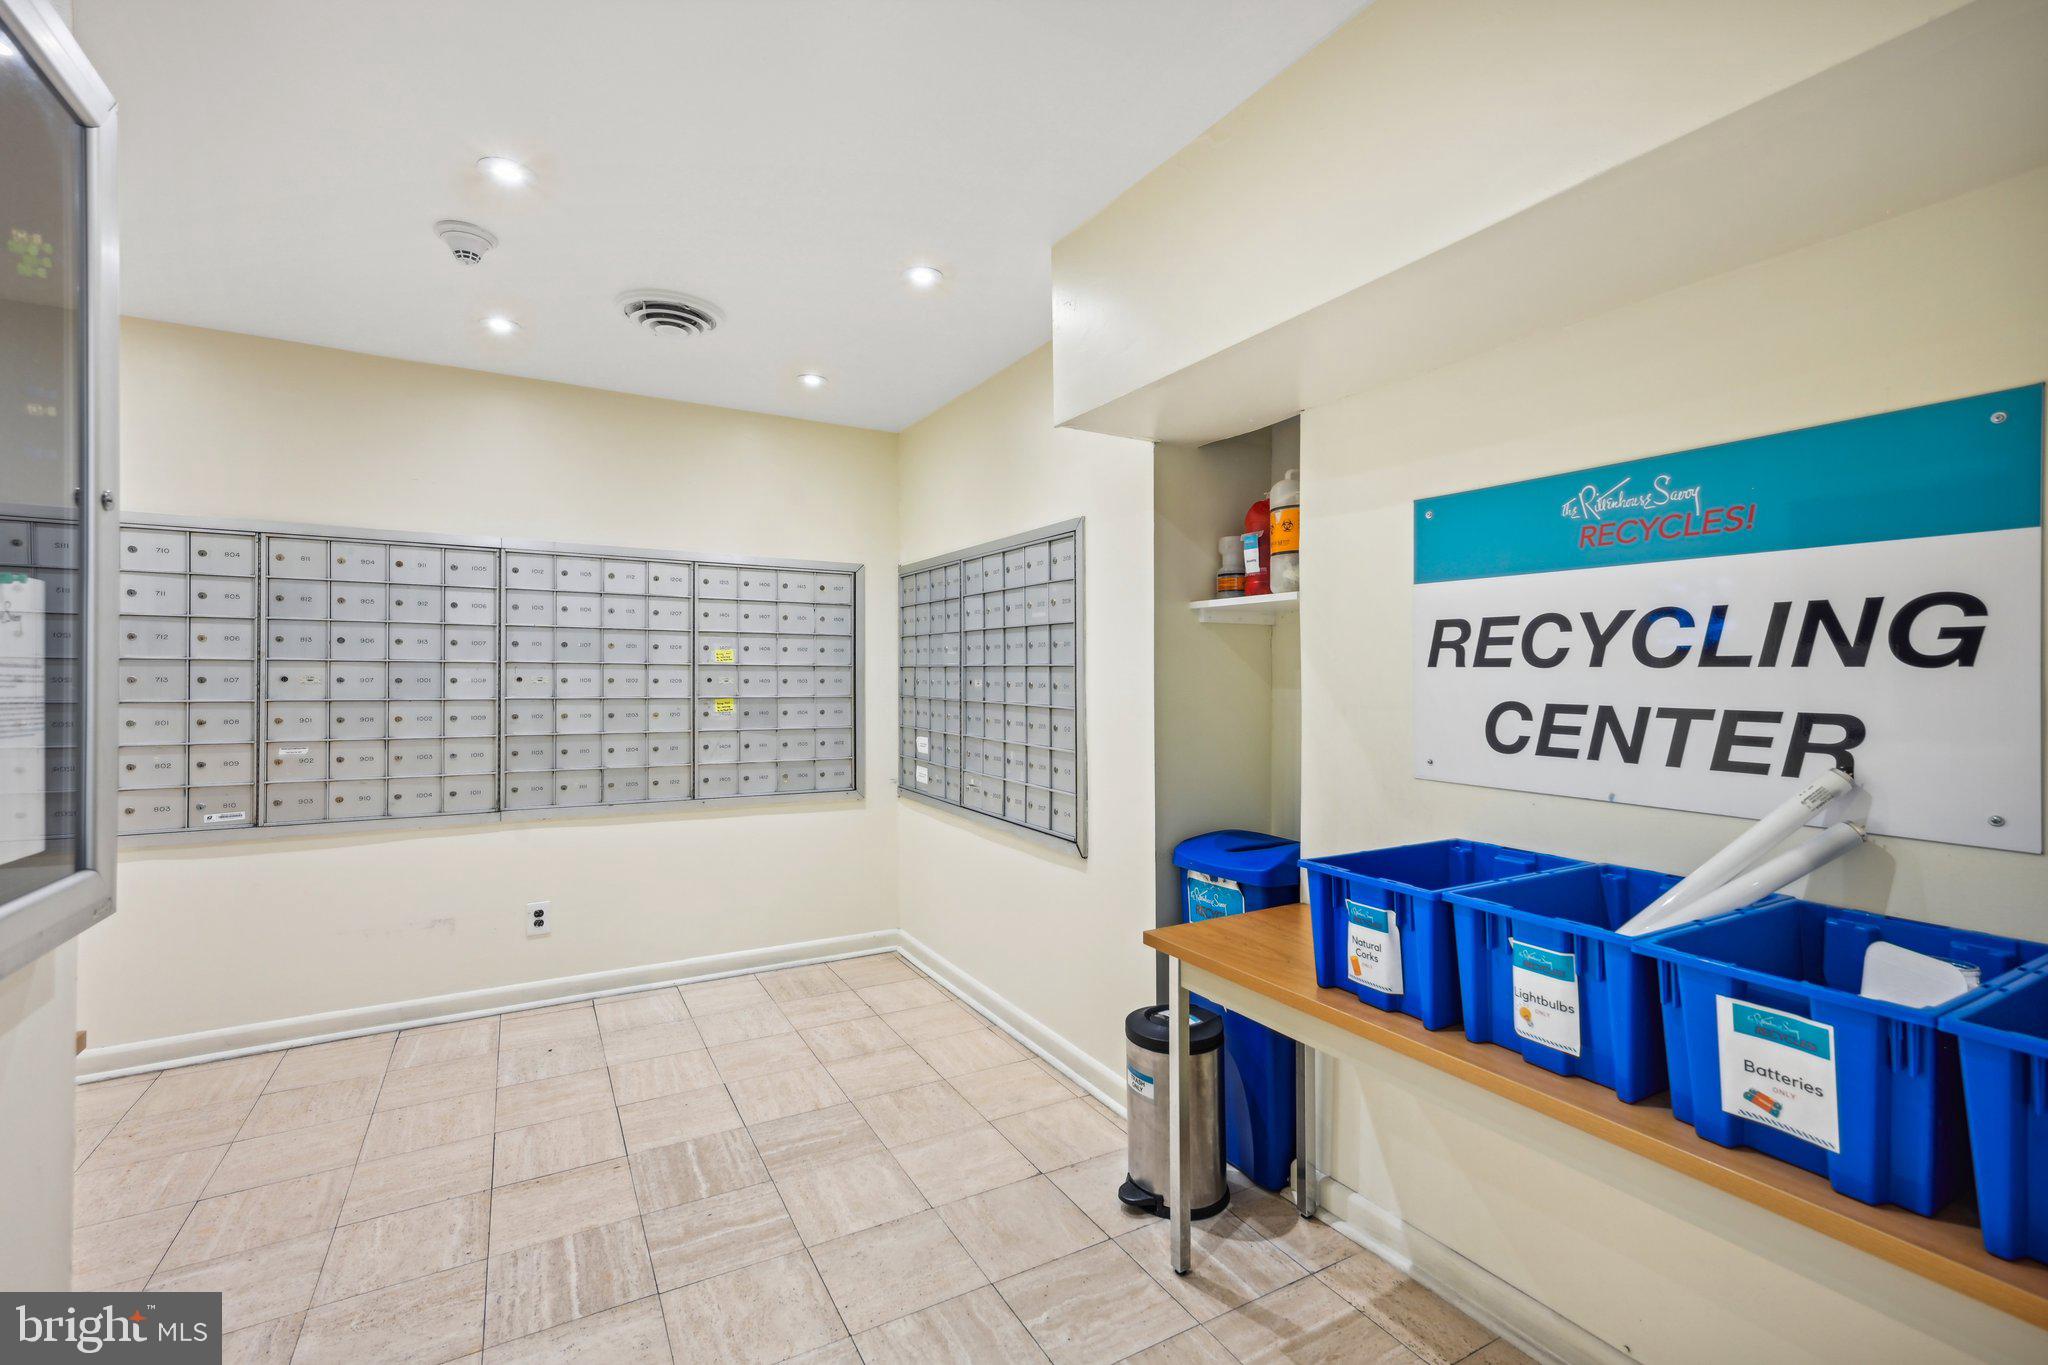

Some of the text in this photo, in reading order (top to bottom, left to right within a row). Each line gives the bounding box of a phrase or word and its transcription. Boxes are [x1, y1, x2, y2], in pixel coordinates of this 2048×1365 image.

[1580, 477, 1656, 520] Rittenhouse
[1653, 475, 1701, 516] Savoy
[1579, 504, 1756, 549] RECYCLES!
[155, 546, 170, 554] 710
[1427, 591, 1989, 669] RECYCLING
[471, 640, 487, 648] 1007
[416, 676, 431, 684] 1001
[154, 719, 169, 727] 801
[223, 718, 240, 726] 808
[416, 715, 433, 724] 1002
[1484, 701, 1868, 780] CENTER
[359, 754, 374, 762] 909
[470, 752, 485, 760] 1010
[298, 757, 314, 765] 902
[154, 762, 172, 770] 802
[358, 794, 372, 802] 910
[153, 805, 171, 813] 803
[1352, 934, 1382, 952] Natural
[1355, 948, 1379, 963] Corks
[1514, 986, 1575, 1014] Lightbulbs
[1744, 1059, 1824, 1098] Batteries
[1771, 1086, 1797, 1100] ONLY
